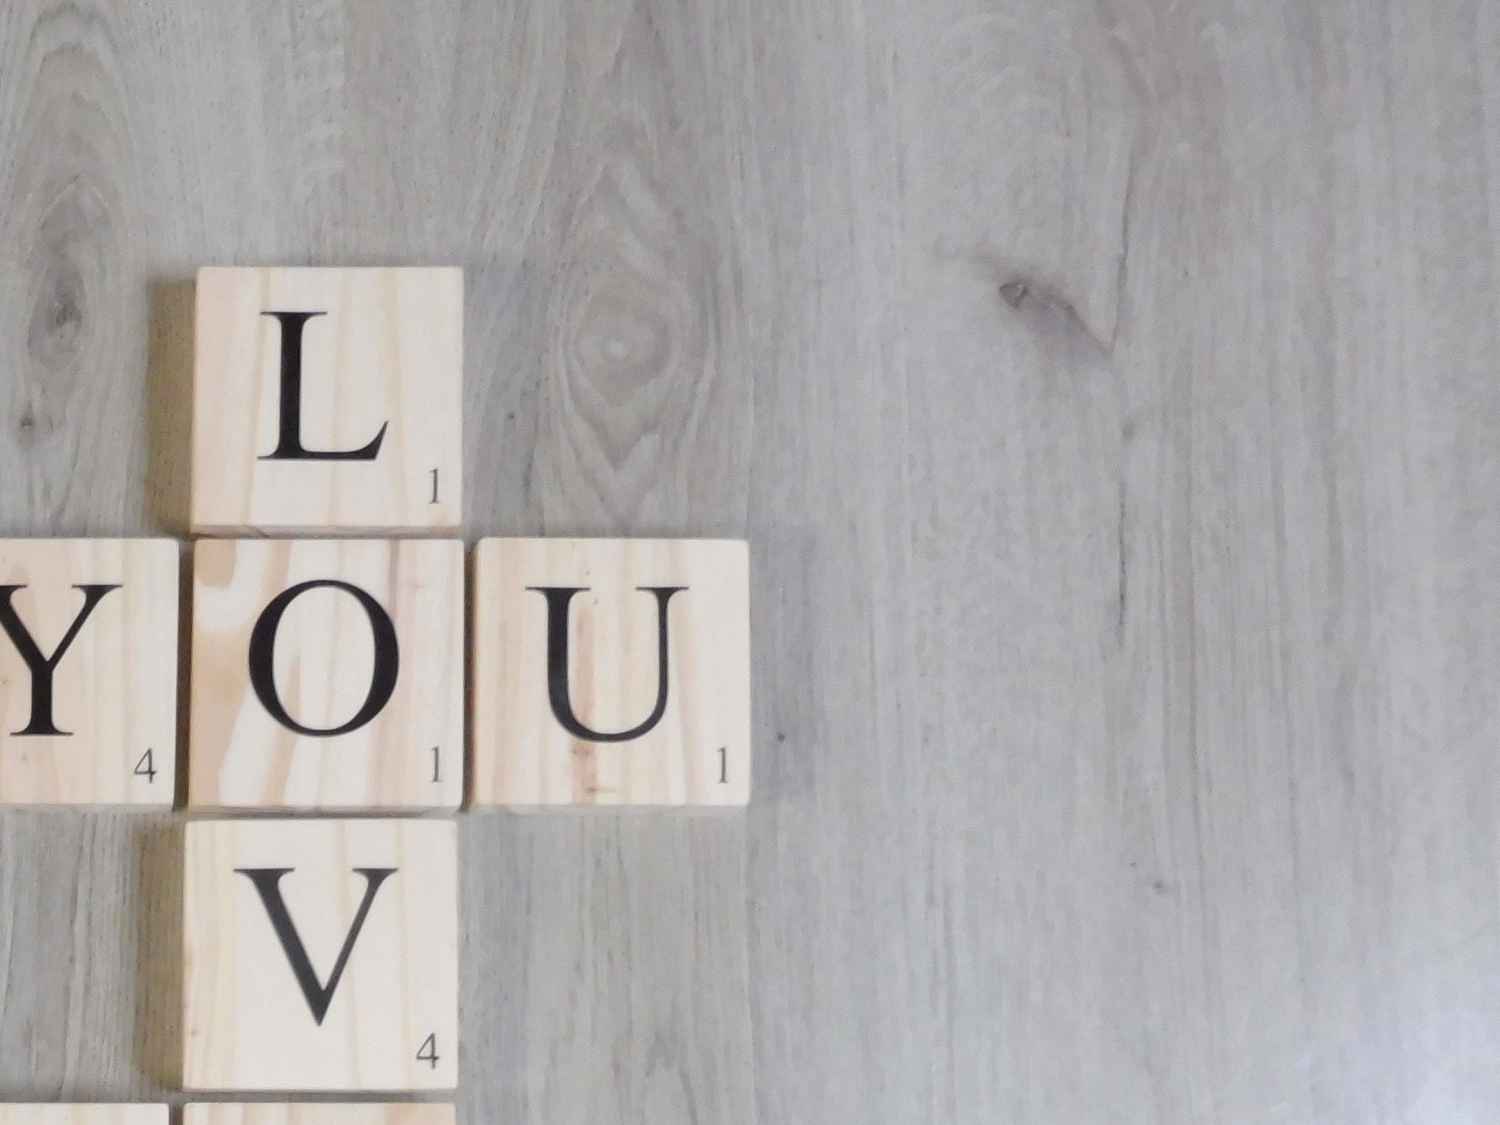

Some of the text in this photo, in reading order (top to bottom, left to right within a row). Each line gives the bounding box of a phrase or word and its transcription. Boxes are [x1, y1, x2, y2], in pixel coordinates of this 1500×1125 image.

[428, 468, 441, 505] 1
[132, 747, 159, 786] 4
[430, 746, 442, 784] 1
[717, 747, 730, 785] 1
[414, 1031, 442, 1071] 4
